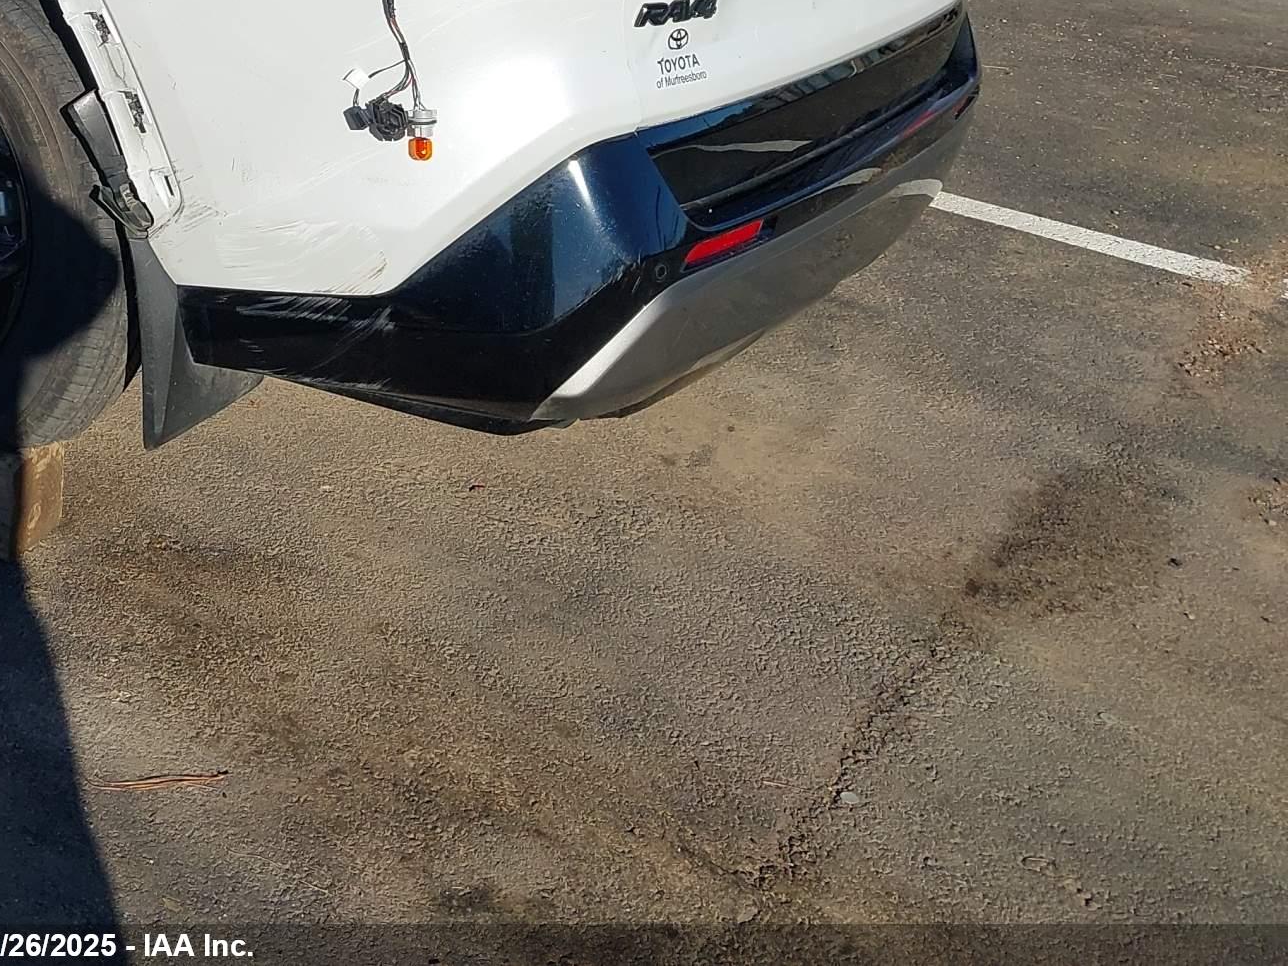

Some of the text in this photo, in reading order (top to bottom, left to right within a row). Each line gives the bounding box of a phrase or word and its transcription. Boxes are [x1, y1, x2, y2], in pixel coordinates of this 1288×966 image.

[657, 54, 700, 75] TOYOTA
[656, 71, 707, 89] of Murfreesboro
